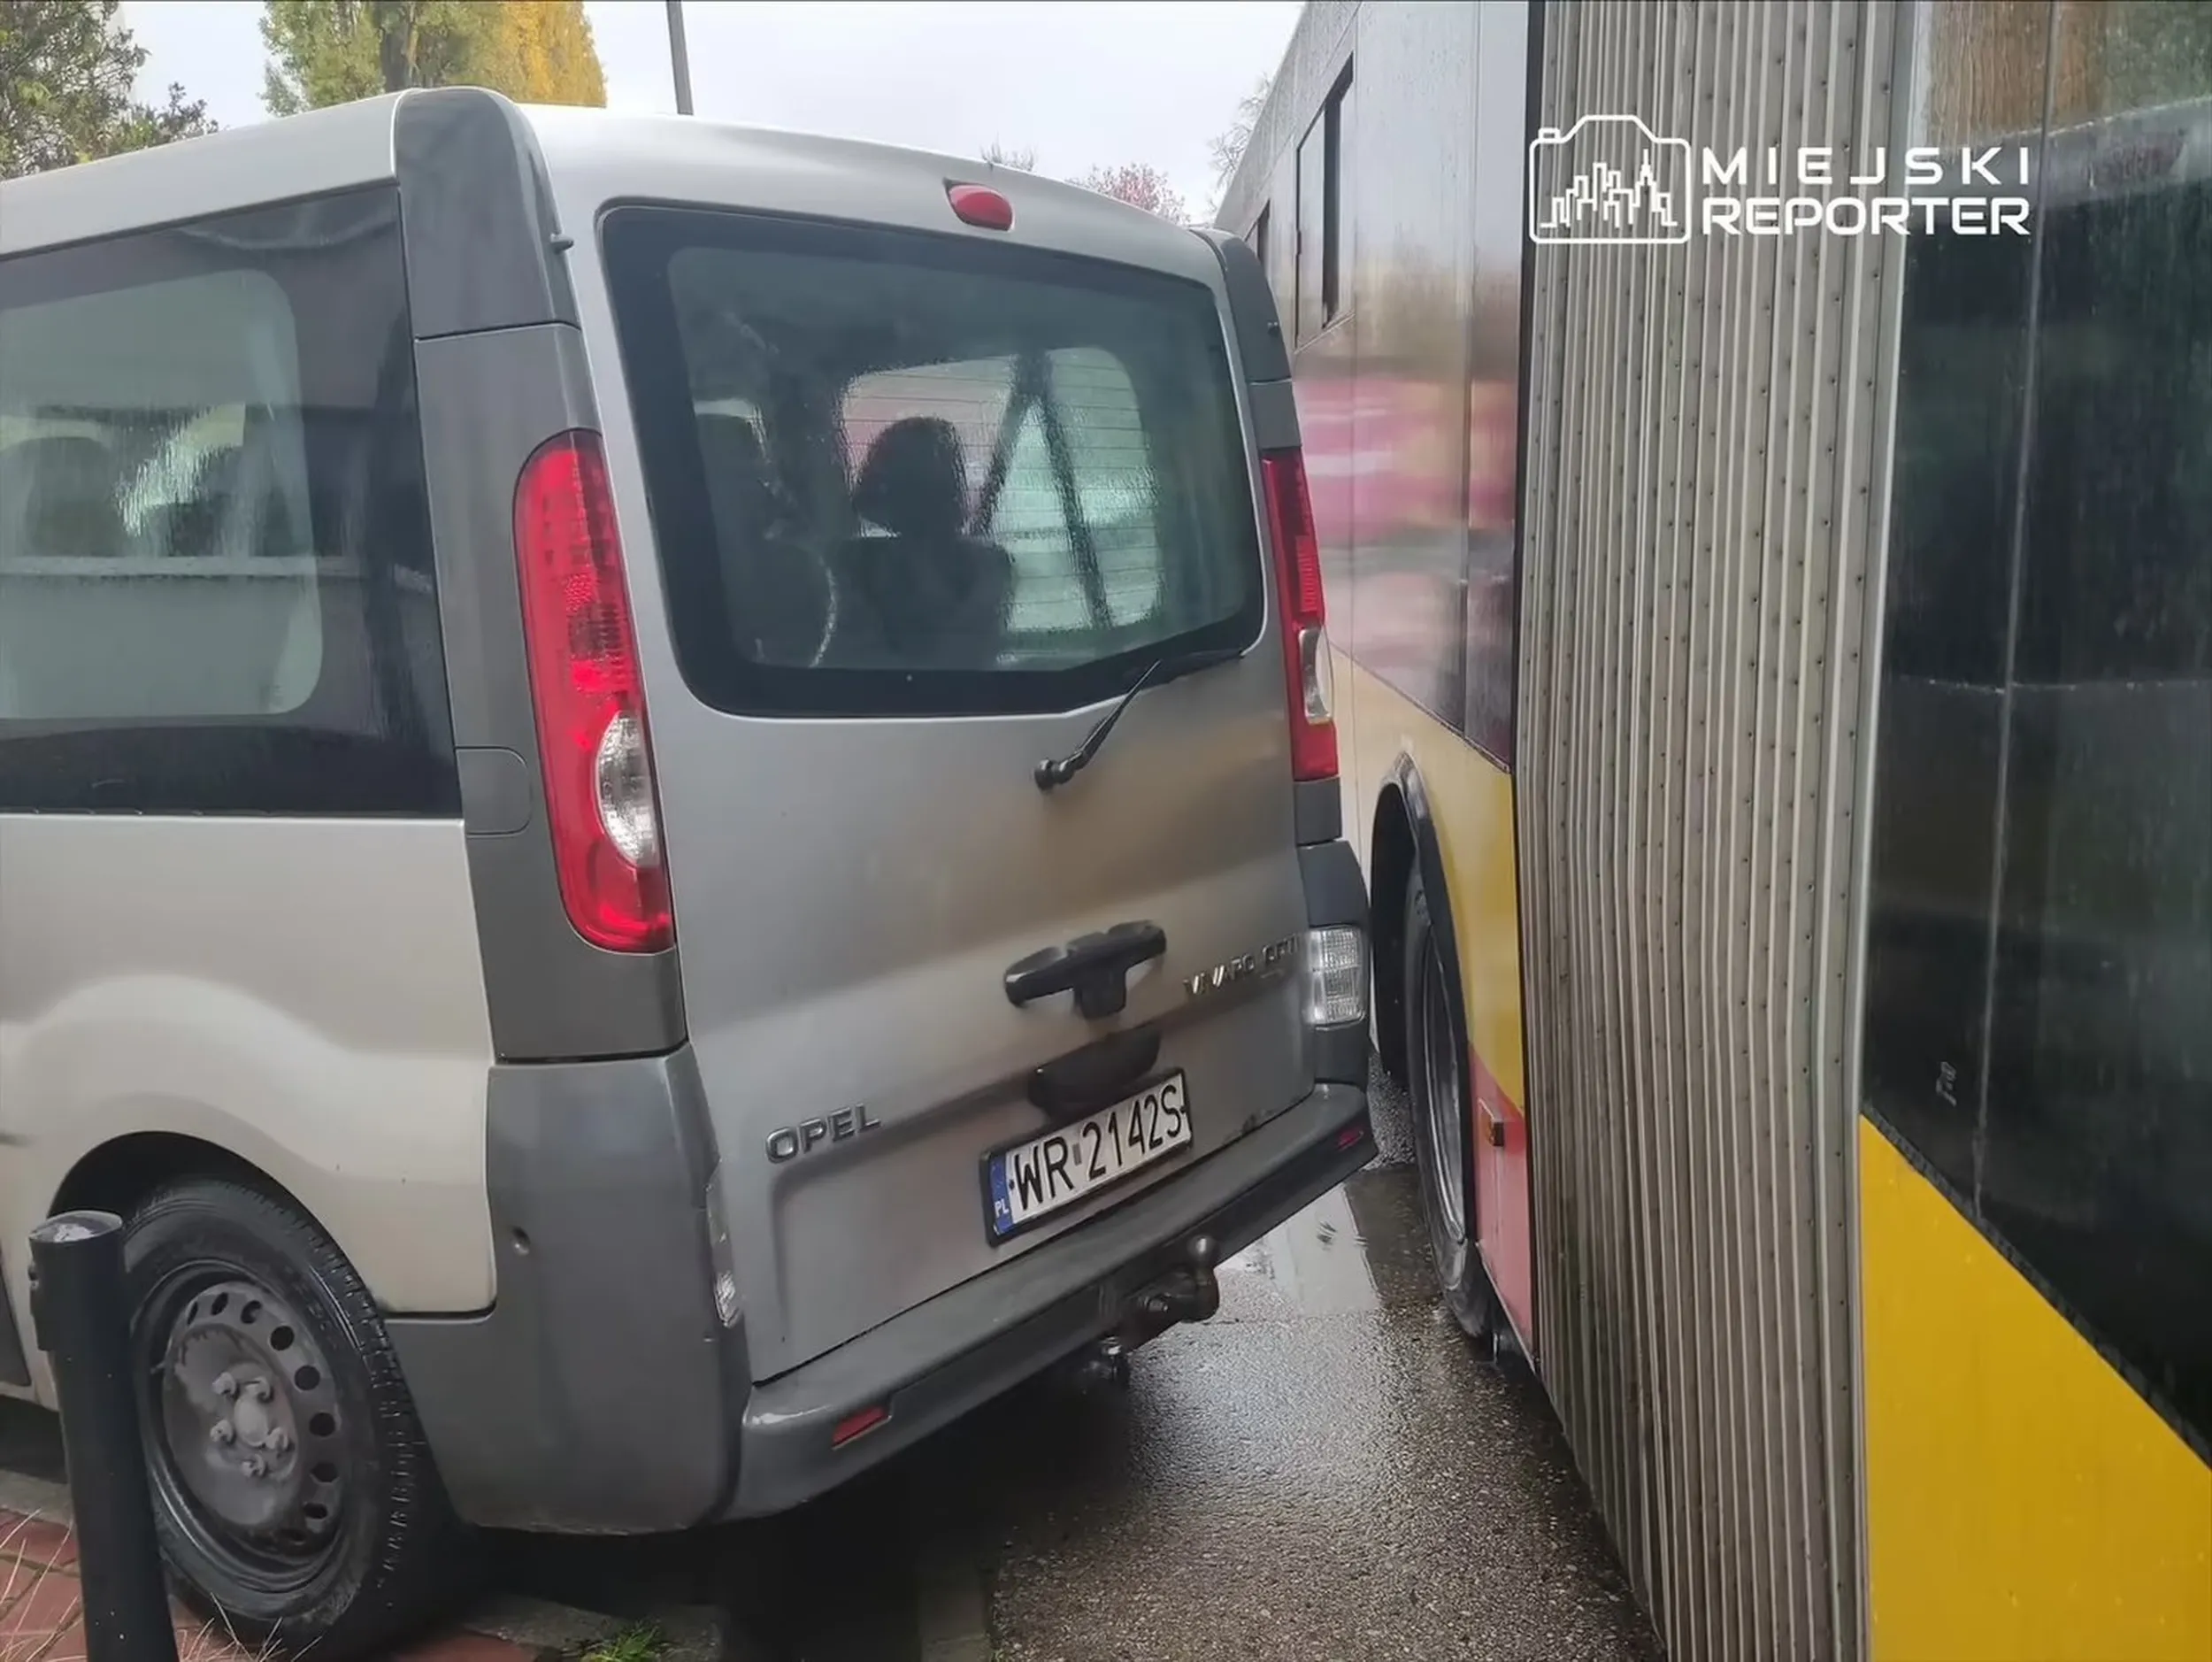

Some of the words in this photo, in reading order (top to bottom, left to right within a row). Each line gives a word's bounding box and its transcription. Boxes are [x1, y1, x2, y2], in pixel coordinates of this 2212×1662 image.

[765, 1102, 882, 1165] OPEL
[1013, 1135, 1075, 1211] WR
[1081, 1084, 1182, 1182] 2142S
[994, 1200, 1010, 1219] PL
